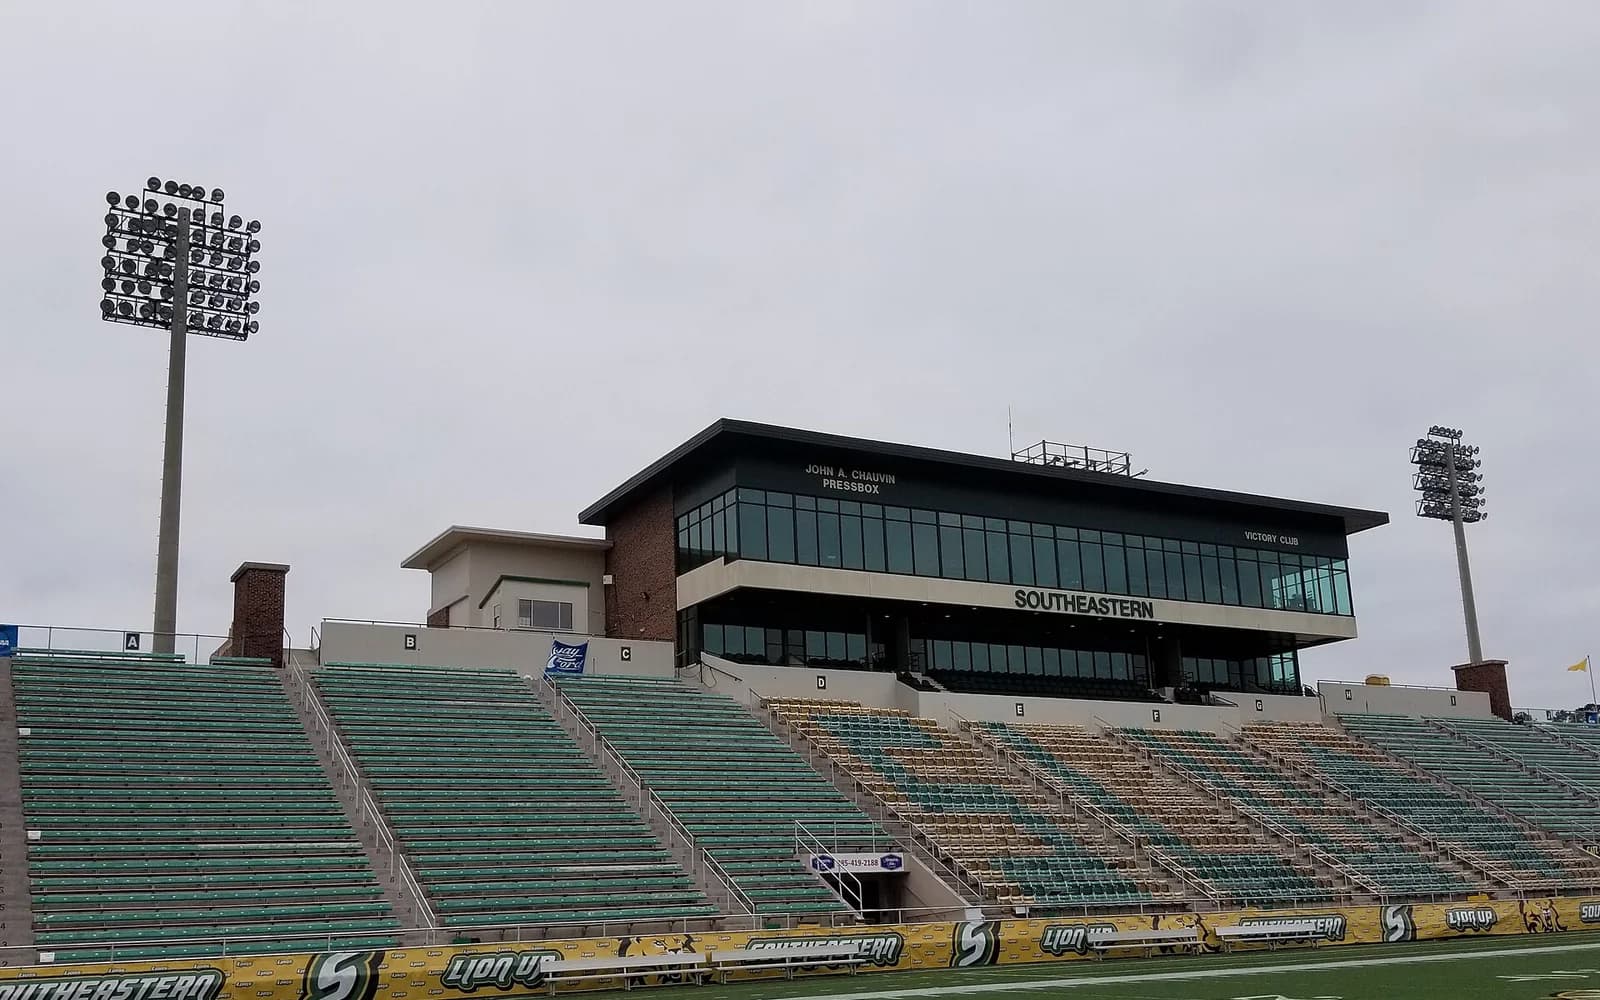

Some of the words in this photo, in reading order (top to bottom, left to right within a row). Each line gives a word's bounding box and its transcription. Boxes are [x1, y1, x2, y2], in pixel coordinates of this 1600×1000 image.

[805, 463, 834, 476] JOHN
[838, 467, 848, 478] A.
[851, 470, 896, 484] CHAUVIN
[823, 478, 880, 494] PRESSBOX
[1244, 531, 1277, 543] VICTORY
[1280, 535, 1299, 546] CLUB
[1014, 589, 1154, 619] SOUTHEASTERN
[127, 636, 138, 648] A
[405, 636, 415, 648] B
[621, 648, 631, 659] C
[817, 677, 826, 688] D
[1016, 704, 1024, 715] E
[1256, 700, 1262, 711] G
[1153, 711, 1159, 721] F
[1449, 910, 1476, 927] LION
[1478, 910, 1493, 926] UP
[1043, 927, 1085, 950] LION
[447, 957, 514, 984] LION
